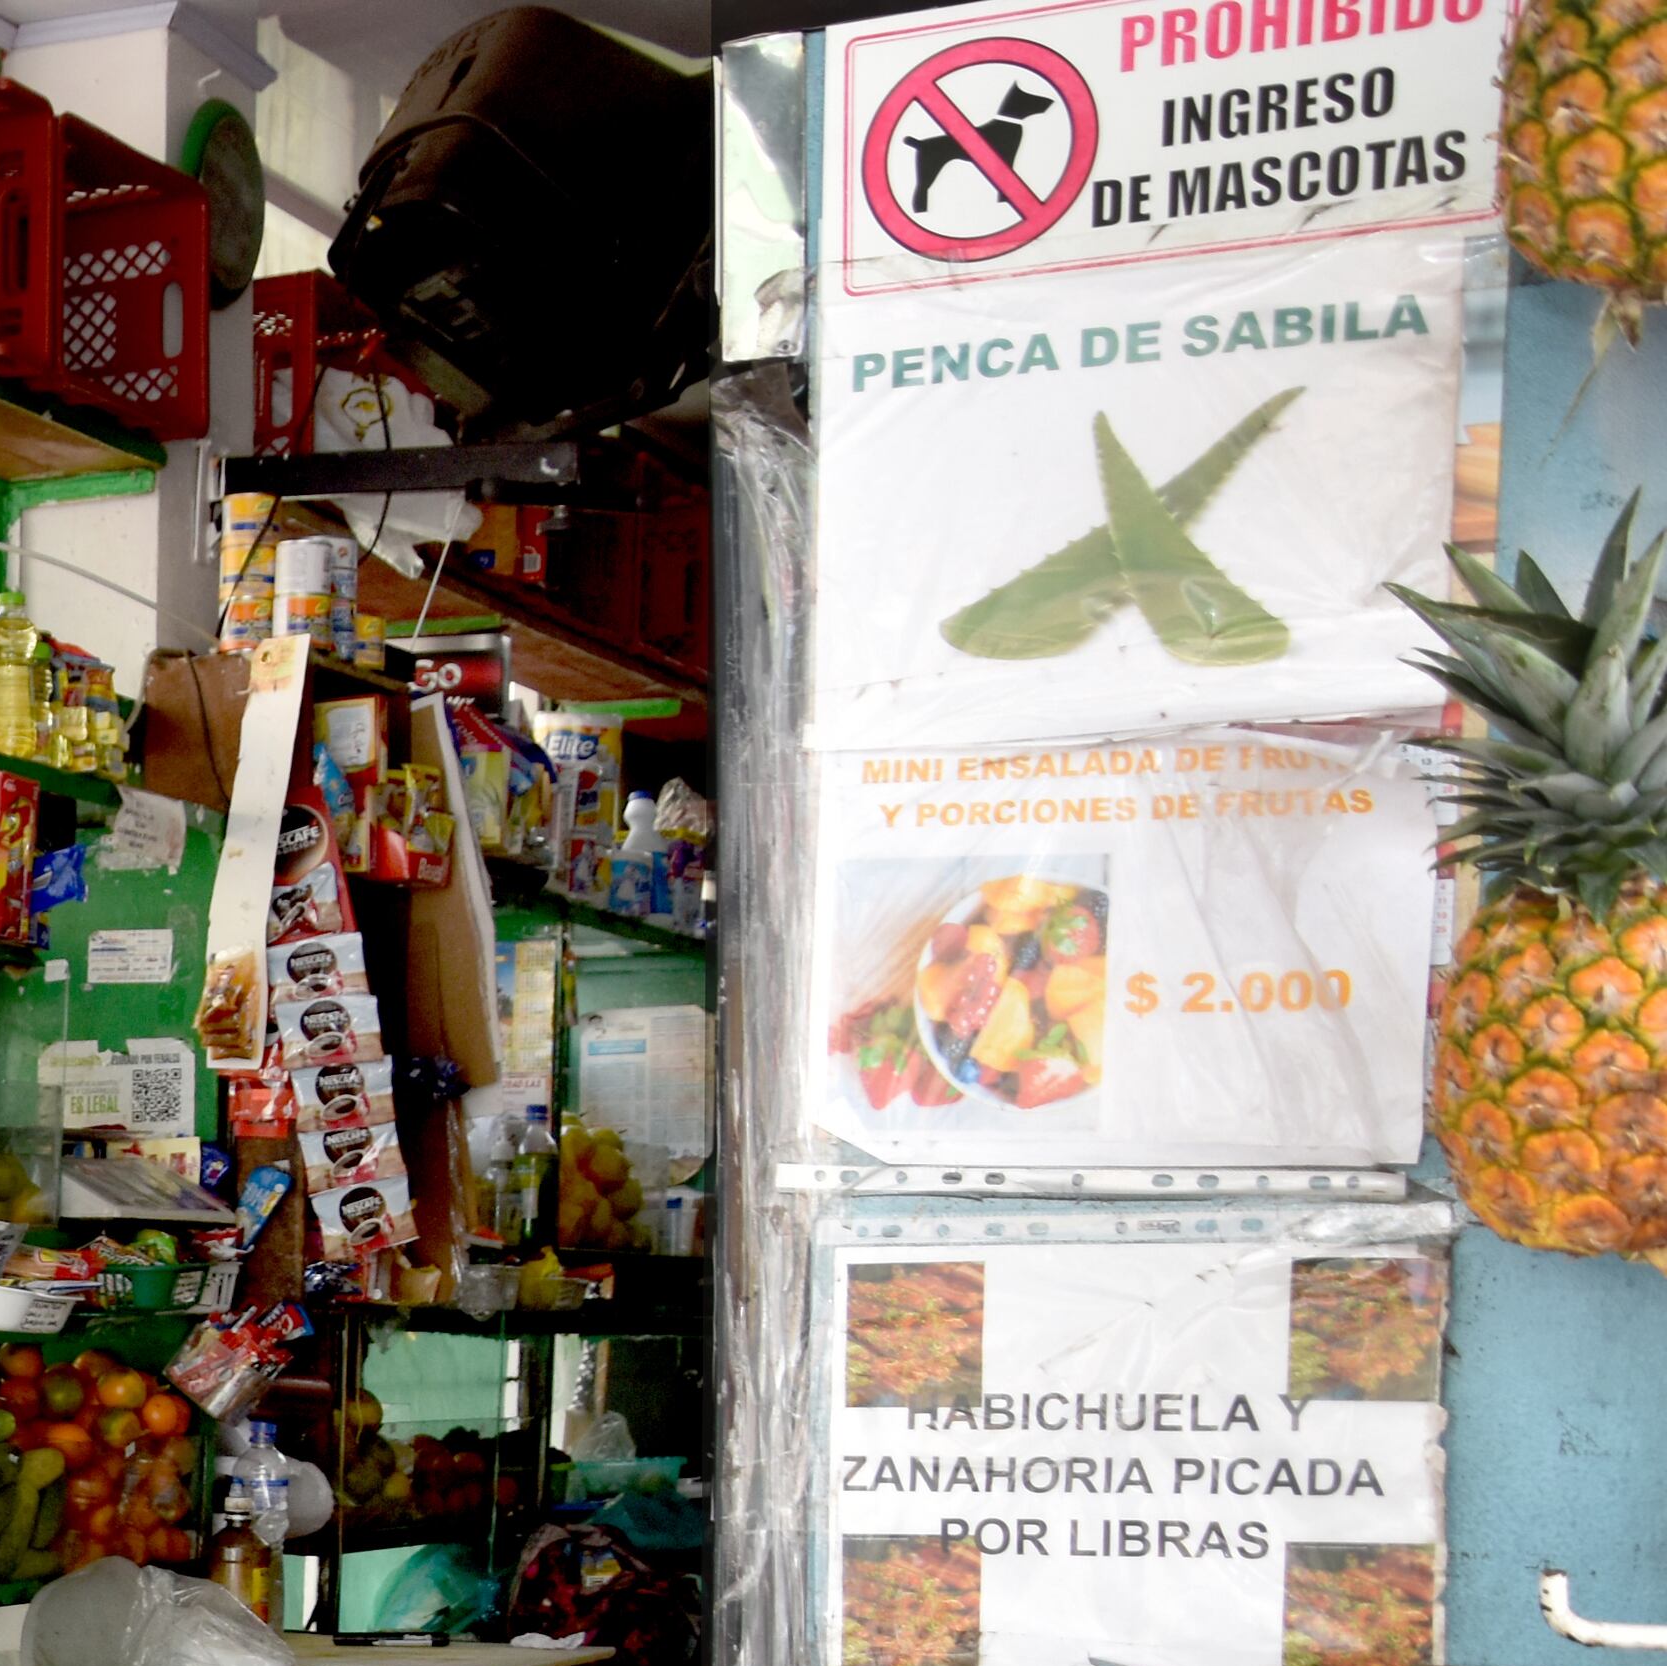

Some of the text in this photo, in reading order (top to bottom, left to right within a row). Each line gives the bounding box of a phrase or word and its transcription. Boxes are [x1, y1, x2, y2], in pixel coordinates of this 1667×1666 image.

[1161, 67, 1394, 148] INGRESO
[1090, 129, 1467, 229] DE MASCOTAS
[851, 295, 1429, 392] PENCA DE SABILA
[547, 732, 598, 758] Elite
[860, 756, 945, 787] MINI
[957, 746, 1163, 783] ENSALADA
[1174, 745, 1226, 774] DE
[880, 788, 1374, 828] Y PORCIONES DE FRUTAS
[1124, 969, 1353, 1019] $ 2.000
[907, 1392, 1311, 1433] HABICHUELA Y
[842, 1455, 1386, 1497] ZANAHORIA PICADA
[939, 1517, 1270, 1560] POR LIBRAS
